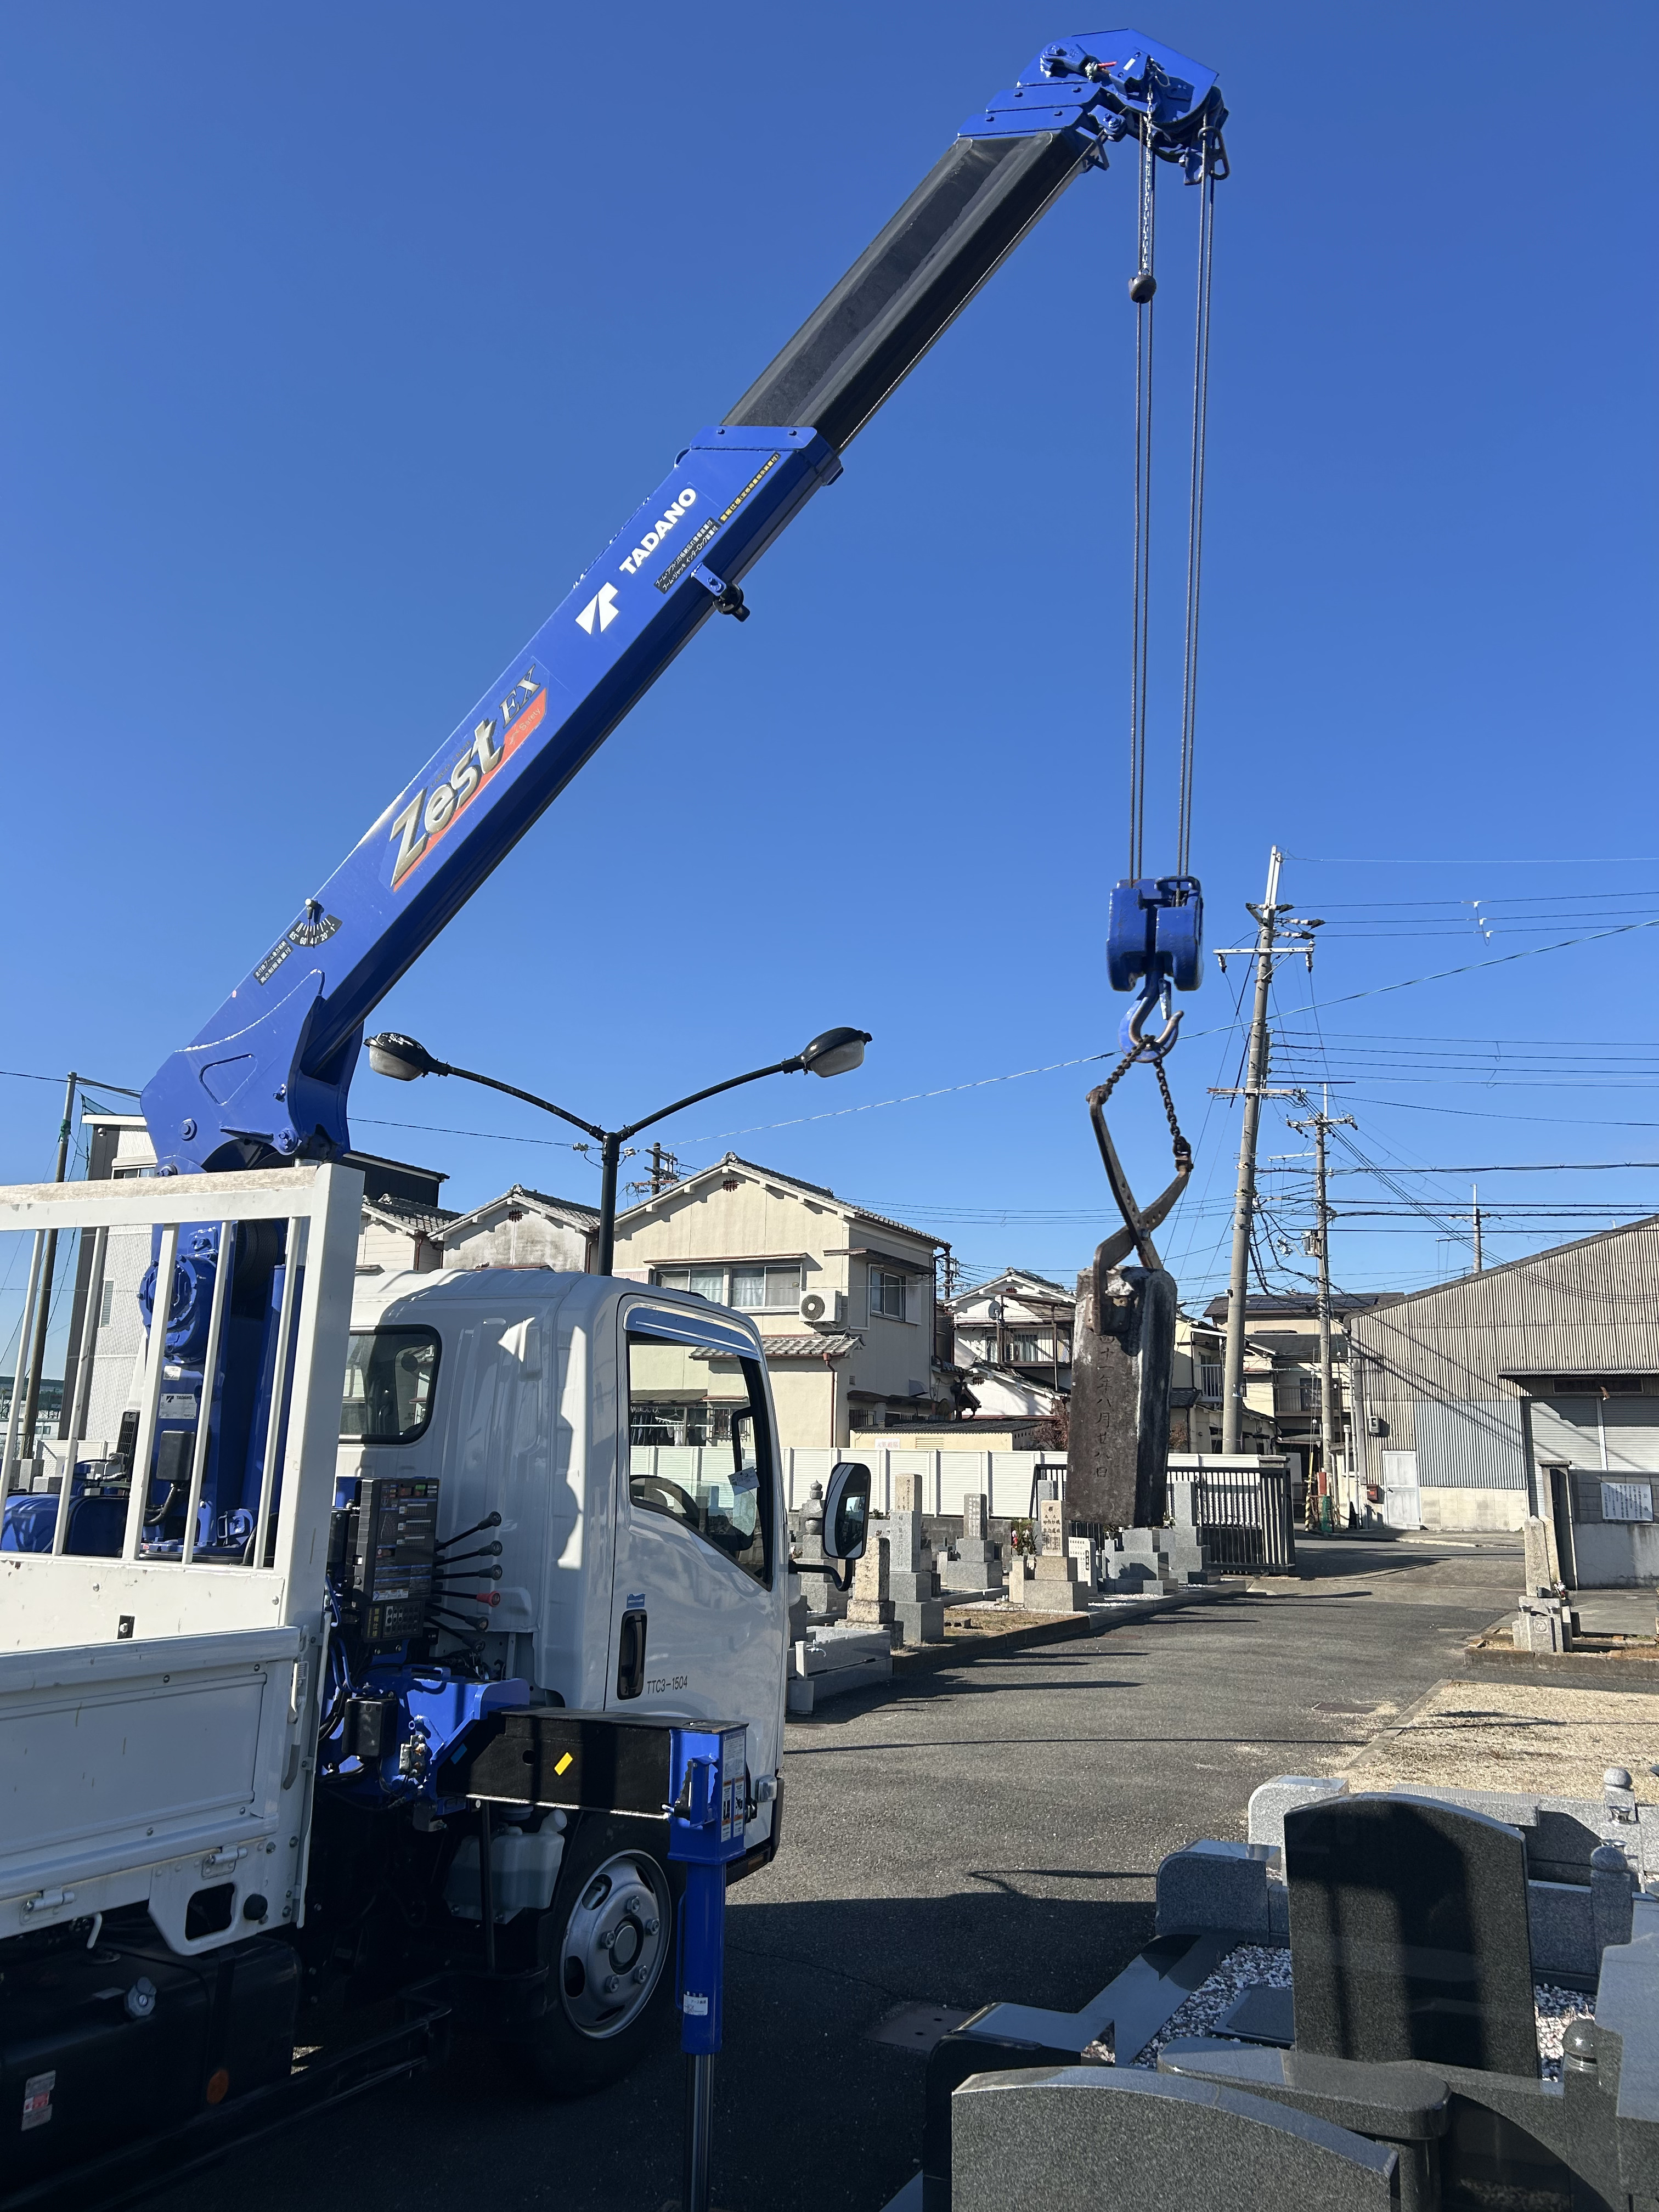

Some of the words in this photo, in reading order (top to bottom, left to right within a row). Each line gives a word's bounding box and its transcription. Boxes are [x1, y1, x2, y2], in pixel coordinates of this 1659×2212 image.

[619, 488, 696, 574] TADANO
[499, 663, 541, 729] EX
[389, 718, 505, 888] Zest
[647, 1675, 689, 1695] TTC3-1504
